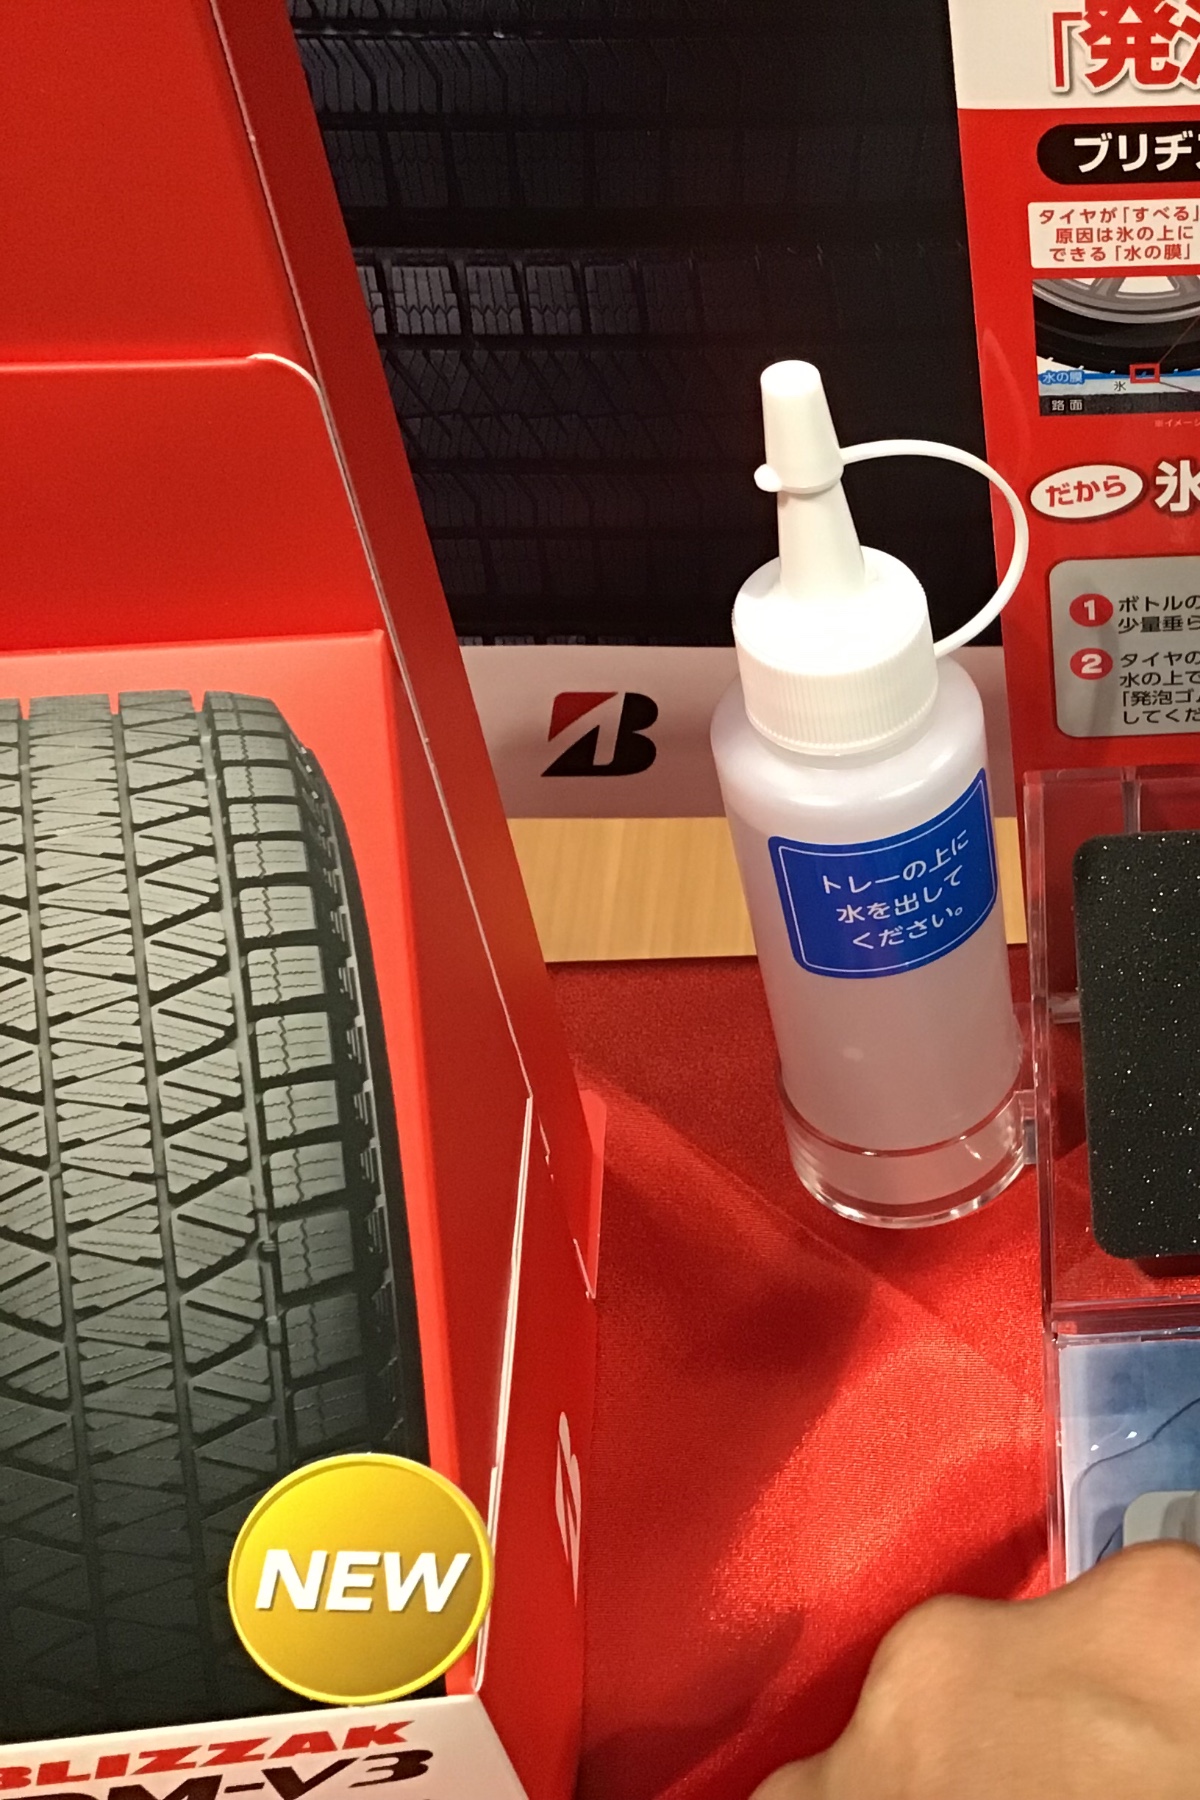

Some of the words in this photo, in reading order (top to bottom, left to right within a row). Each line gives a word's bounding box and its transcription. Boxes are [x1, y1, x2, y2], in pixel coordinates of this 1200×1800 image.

[1039, 205, 1200, 226] タイヤが「すべる」
[1056, 225, 1194, 245] 原因は氷の上に
[1049, 243, 1191, 263] できる「水の膜」
[1042, 371, 1083, 384] 水の膜
[1113, 381, 1126, 392] 氷
[1044, 474, 1128, 507] だから
[1083, 599, 1097, 621] 1
[1080, 654, 1103, 675] 2
[822, 829, 970, 894] トレーの上に
[836, 864, 963, 924] 水を出して
[852, 906, 964, 949] ください。
[256, 1549, 471, 1613] NEW
